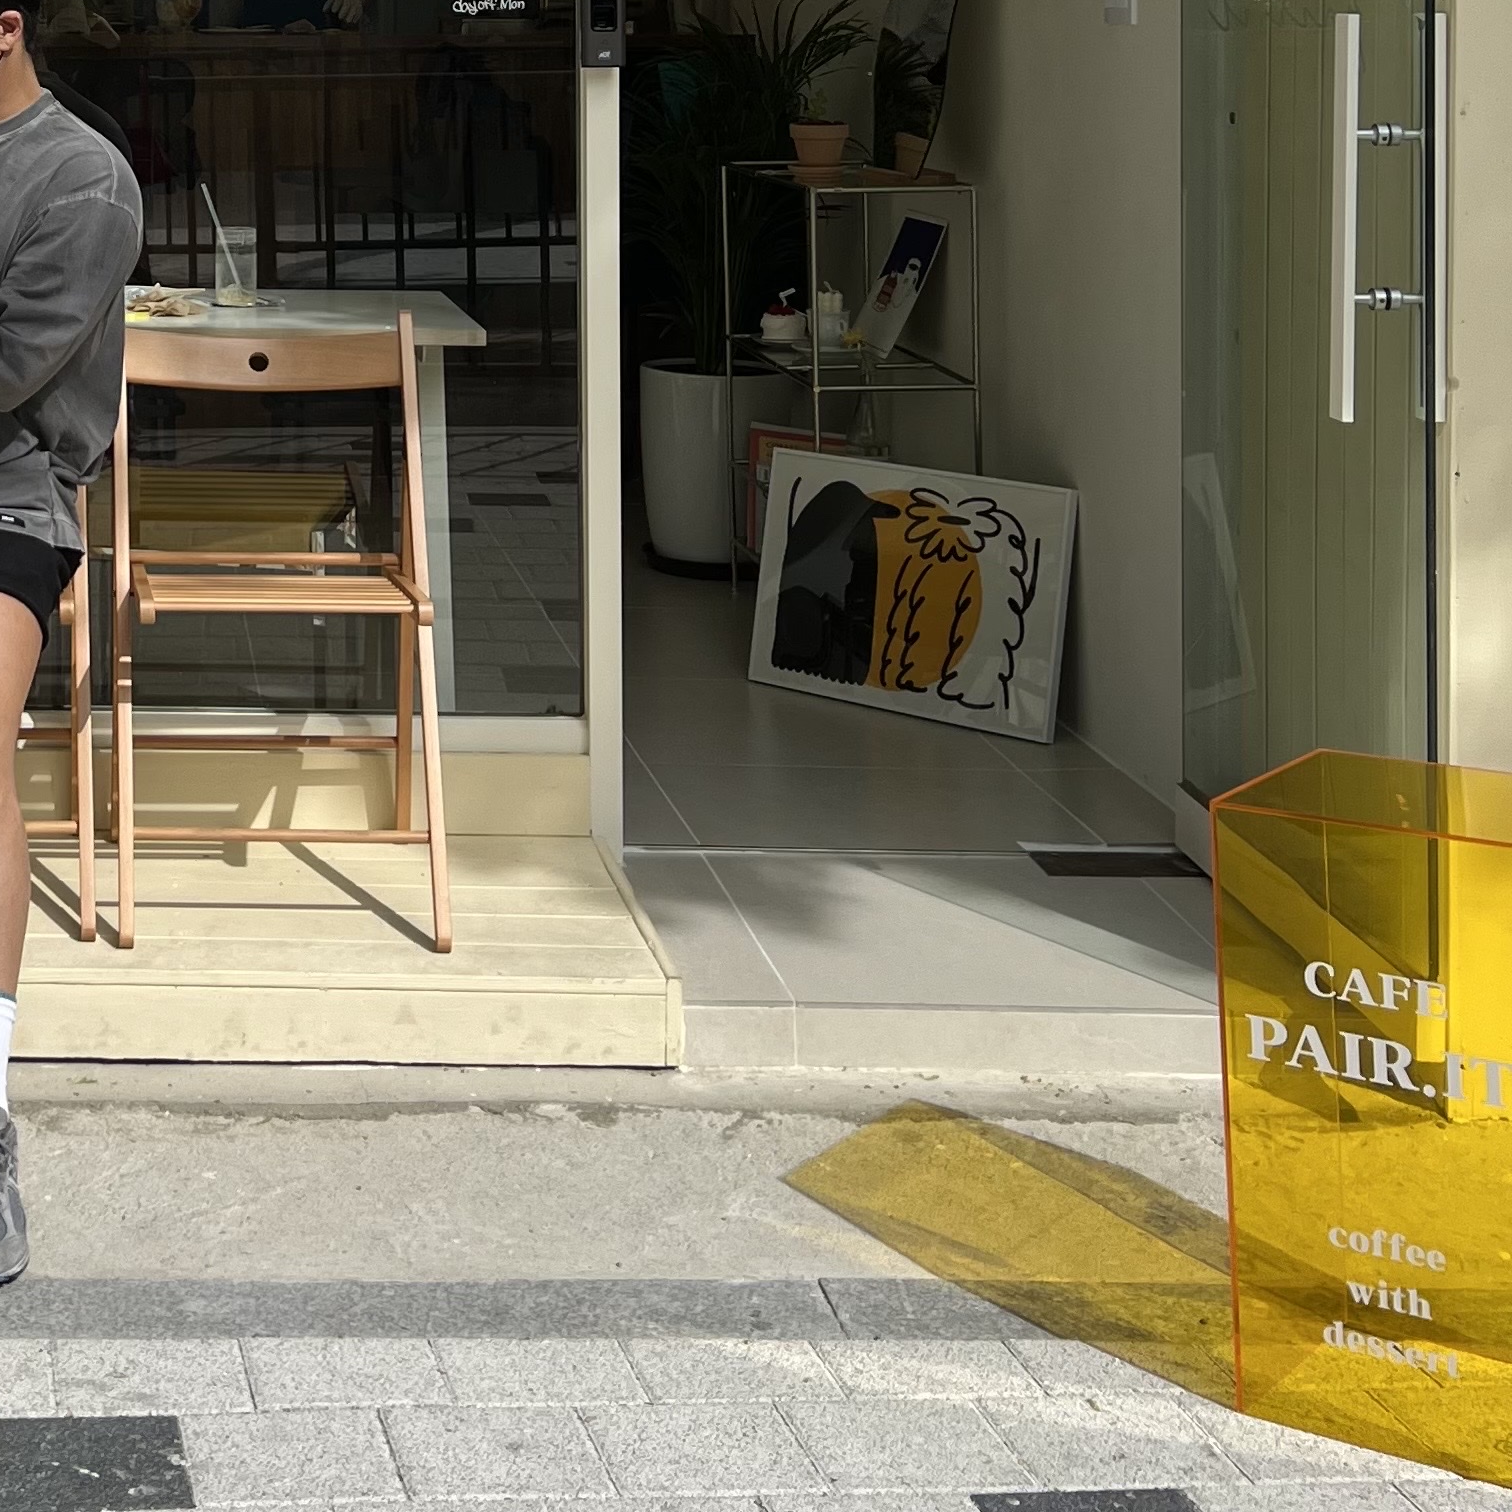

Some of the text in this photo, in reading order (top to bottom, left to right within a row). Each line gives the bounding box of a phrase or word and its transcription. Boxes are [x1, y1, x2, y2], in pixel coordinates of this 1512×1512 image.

[1303, 960, 1448, 1019] CAFE
[1244, 1012, 1512, 1108] PAIR.IT
[1328, 1226, 1448, 1273] coffee
[1346, 1278, 1434, 1322] with
[1322, 1319, 1461, 1380] dessert
